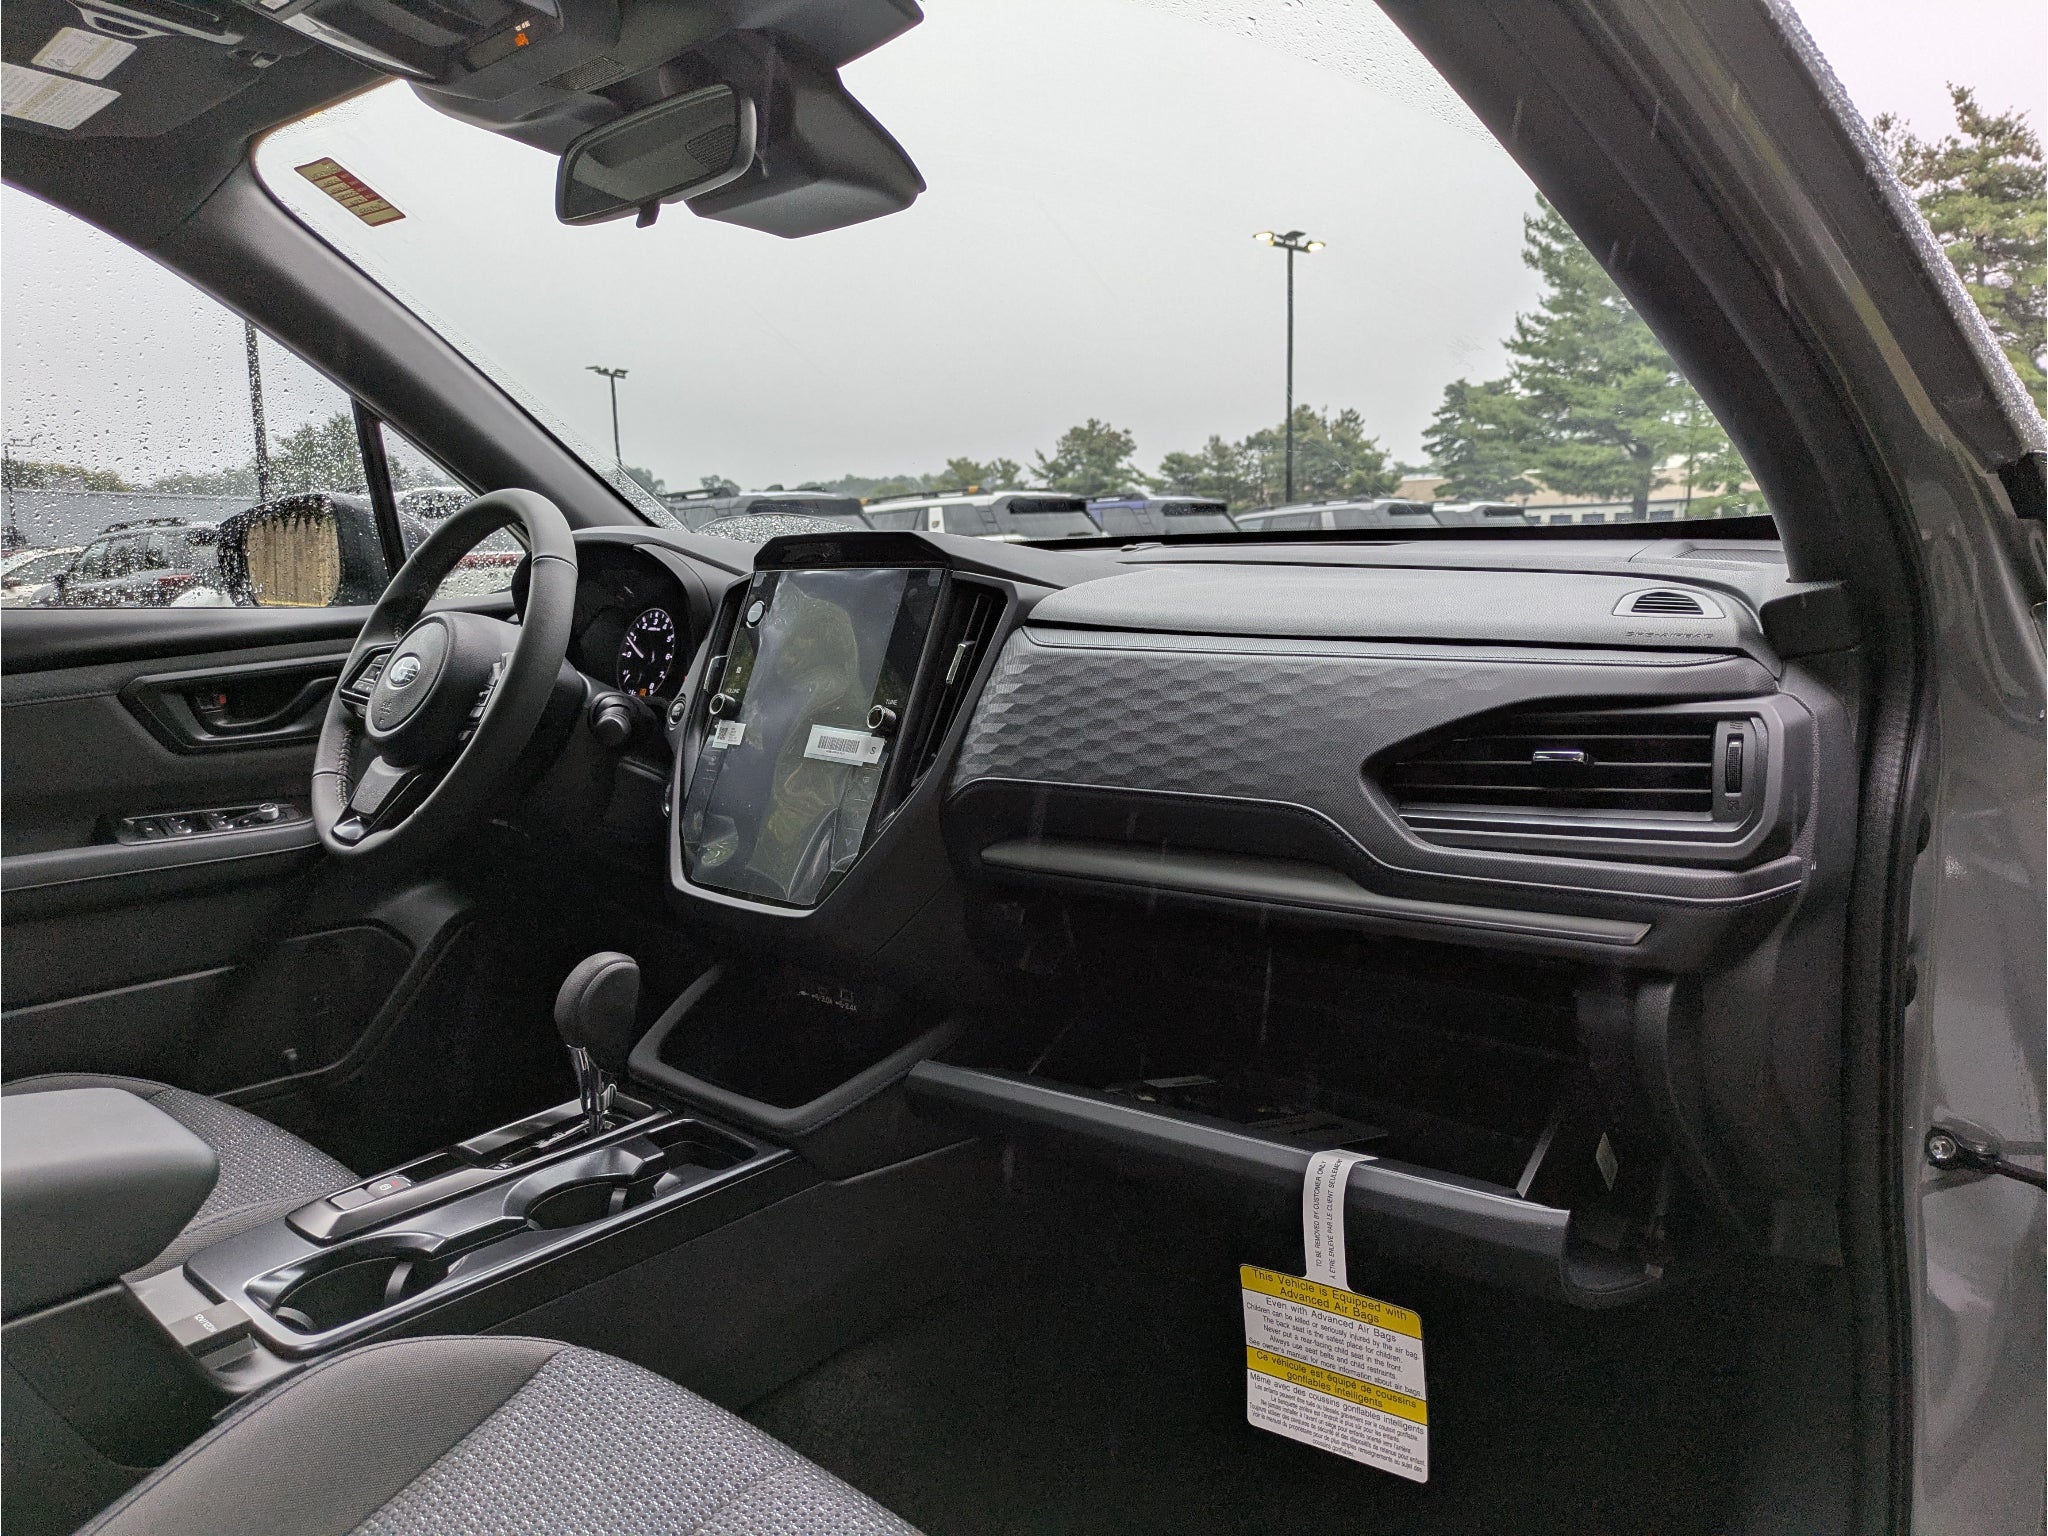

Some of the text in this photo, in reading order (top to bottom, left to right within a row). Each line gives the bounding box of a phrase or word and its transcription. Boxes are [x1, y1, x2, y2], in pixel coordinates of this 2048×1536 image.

[870, 746, 877, 755] S
[1317, 1160, 1327, 1175] ONLY
[1314, 1176, 1322, 1210] CUSTOMER
[1253, 1269, 1407, 1320] This Vehicle is Equipped with
[1280, 1286, 1380, 1325] Advanced Air Bags
[1266, 1297, 1397, 1344] Even with Advanced Air Bags
[1257, 1350, 1417, 1408] Ce véhicule est équipé de coussins
[1287, 1370, 1383, 1410] gonflables intelligents
[1274, 1381, 1291, 1392] avec
[1293, 1386, 1306, 1397] des
[1309, 1391, 1340, 1408] coussins
[1343, 1402, 1381, 1422] gonflables
